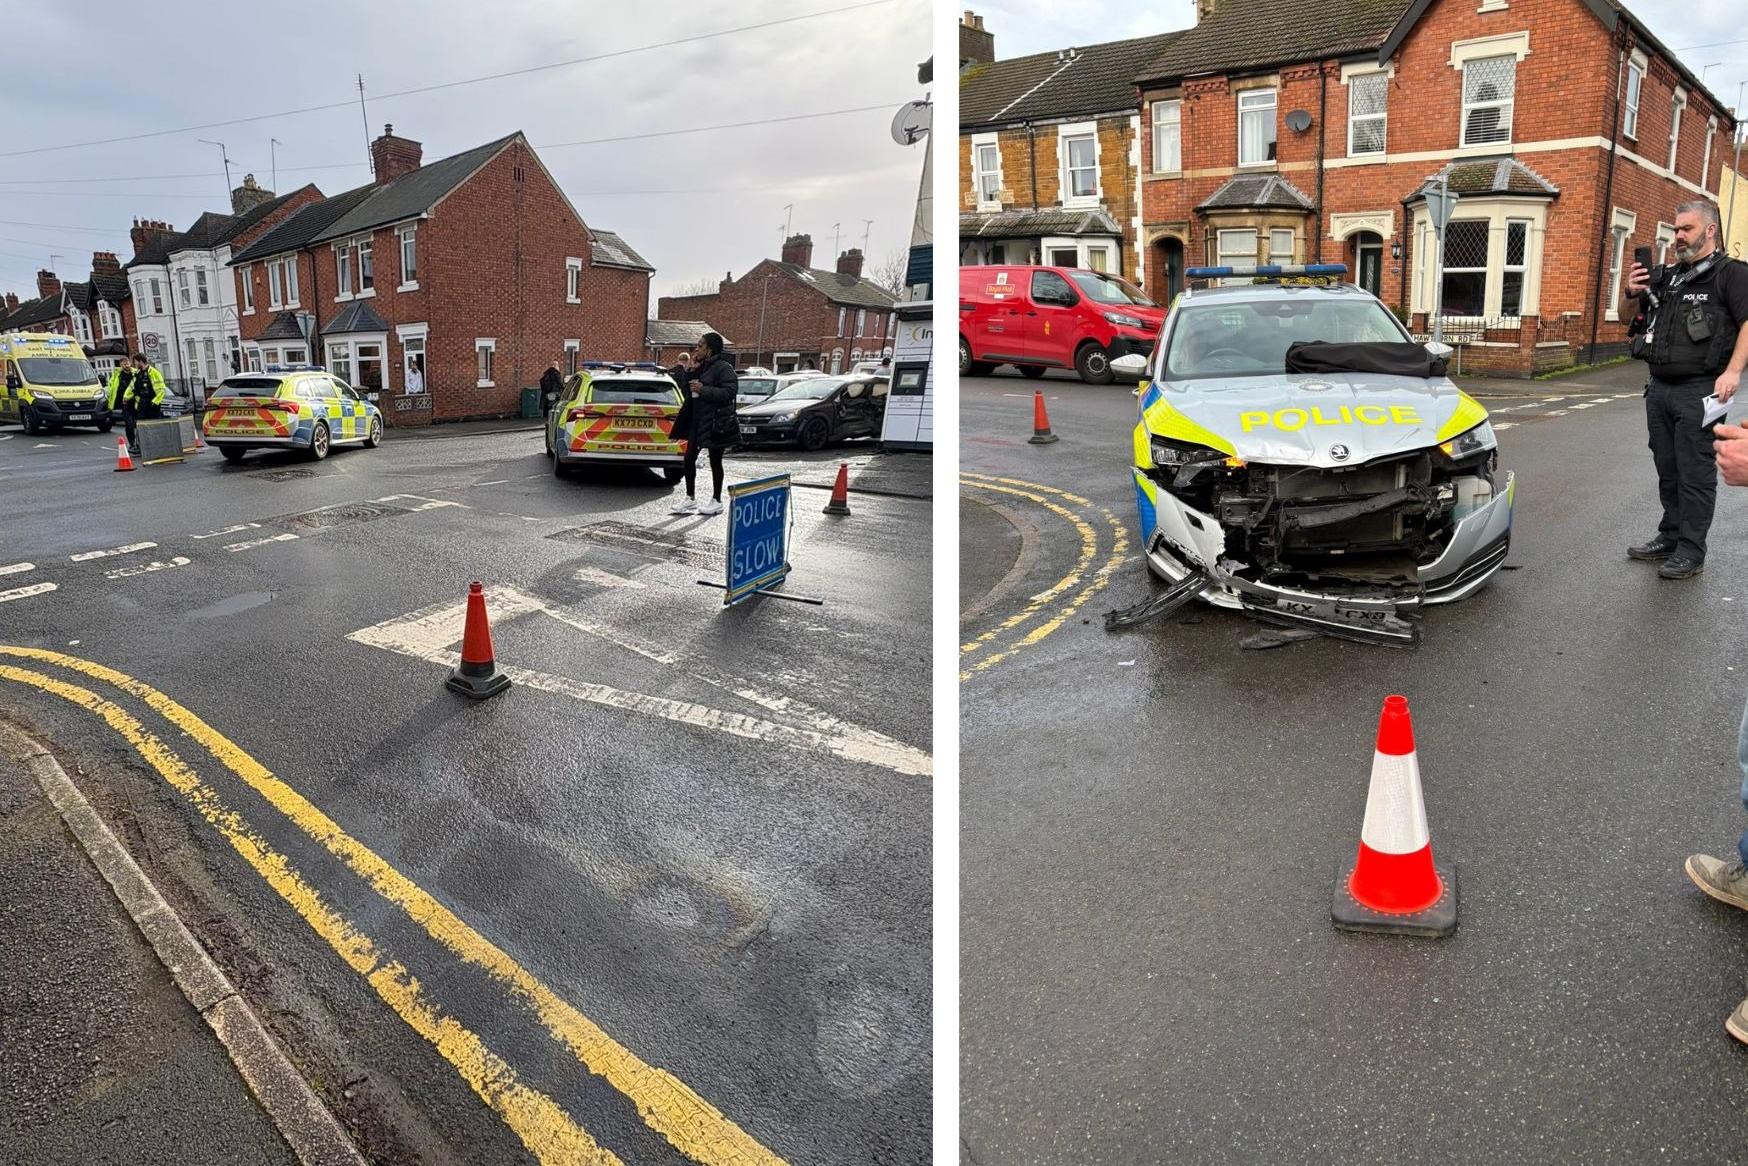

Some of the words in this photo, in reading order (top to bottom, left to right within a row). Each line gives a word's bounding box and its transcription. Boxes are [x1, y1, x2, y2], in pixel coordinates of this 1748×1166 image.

[1458, 335, 1468, 343] RD
[614, 418, 635, 429] KX73
[636, 418, 654, 428] CXD
[1239, 404, 1425, 433] POLICE
[598, 443, 668, 451] POLICE
[734, 495, 782, 528] POLICE
[733, 535, 781, 580] SLOW
